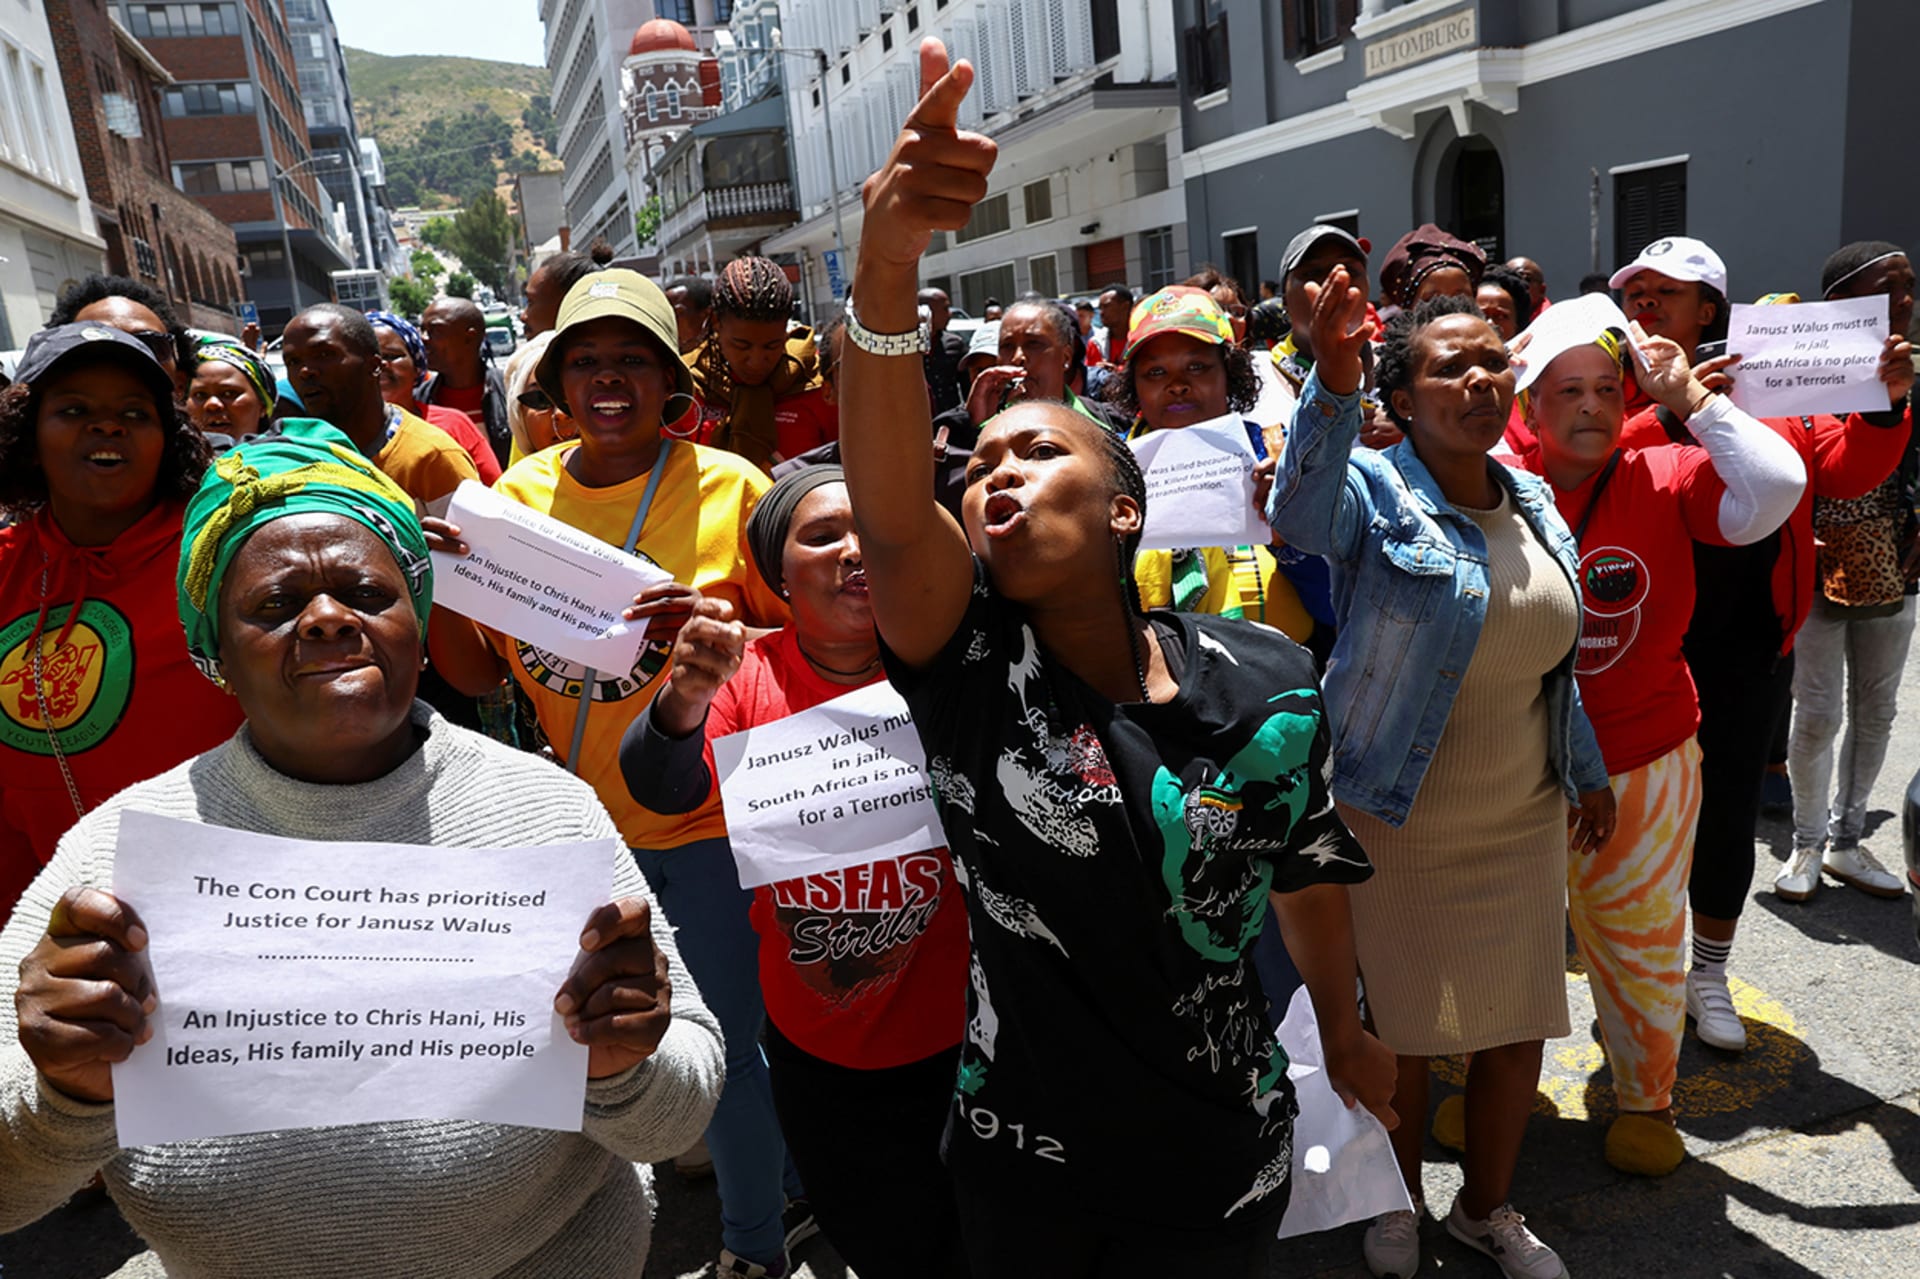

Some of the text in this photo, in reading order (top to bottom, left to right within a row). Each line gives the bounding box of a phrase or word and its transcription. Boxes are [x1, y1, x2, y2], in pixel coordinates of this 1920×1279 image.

[1369, 17, 1470, 70] LUTOMBURG
[1746, 316, 1878, 336] Janusz Walus must rot
[1794, 339, 1830, 351] in jail,
[1737, 355, 1876, 371] South Africa is no place
[1765, 374, 1846, 388] for a Terrorist
[1150, 466, 1169, 476] was
[1171, 460, 1195, 472] killed
[1197, 455, 1231, 467] because
[1220, 464, 1242, 475] ideas
[1155, 481, 1225, 498] transformation.
[453, 564, 486, 588] Ideas,
[487, 578, 505, 594] His
[506, 586, 539, 611] family
[539, 601, 559, 619] and
[560, 610, 577, 626] His
[467, 552, 616, 624] An Injustice to Chris Hani, His
[1582, 620, 1619, 636] UNITY
[1579, 636, 1619, 649] WORKERS
[746, 711, 912, 770] Janusz Walus mu
[832, 746, 893, 770] in jail,
[747, 764, 919, 813] South Africa is no
[797, 784, 933, 826] for a Terrorist
[193, 875, 547, 909] The Con Court has prioritised
[771, 855, 942, 913] NSFAS
[223, 911, 513, 935] Justice for Janusz Walus
[183, 1007, 527, 1032] An Injustice to Chris Hani, His
[167, 1039, 536, 1067] Ideas, His family and His people
[957, 1093, 1066, 1163] 1912
